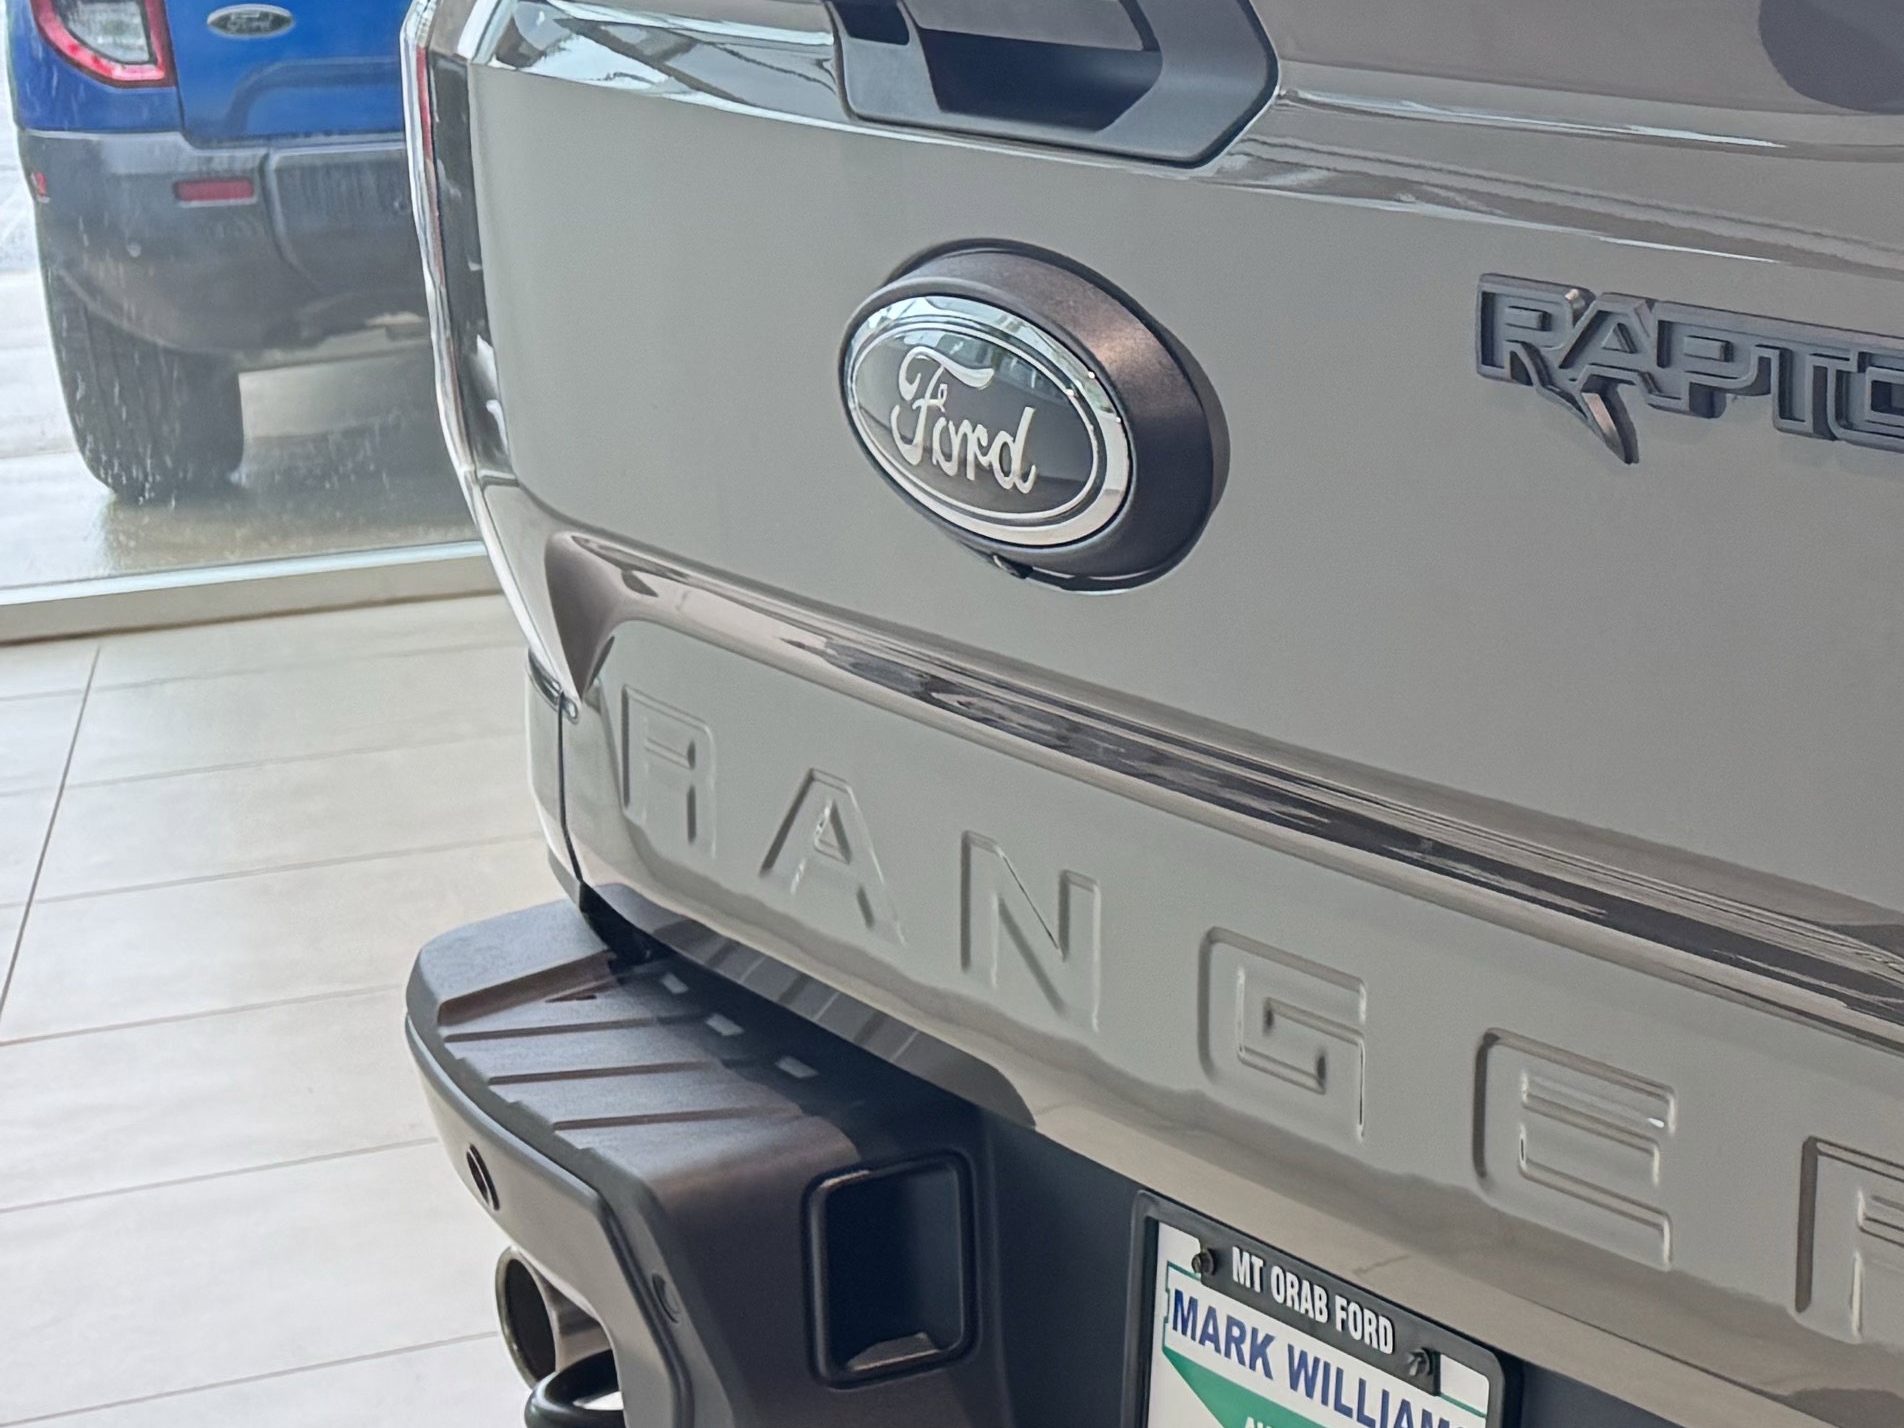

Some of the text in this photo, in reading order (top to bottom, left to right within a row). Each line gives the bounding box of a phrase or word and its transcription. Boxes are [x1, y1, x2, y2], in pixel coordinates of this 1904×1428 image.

[890, 346, 1036, 494] Ford
[1172, 1288, 1276, 1381] MARK
[1232, 1246, 1395, 1355] MT ORAB FORD
